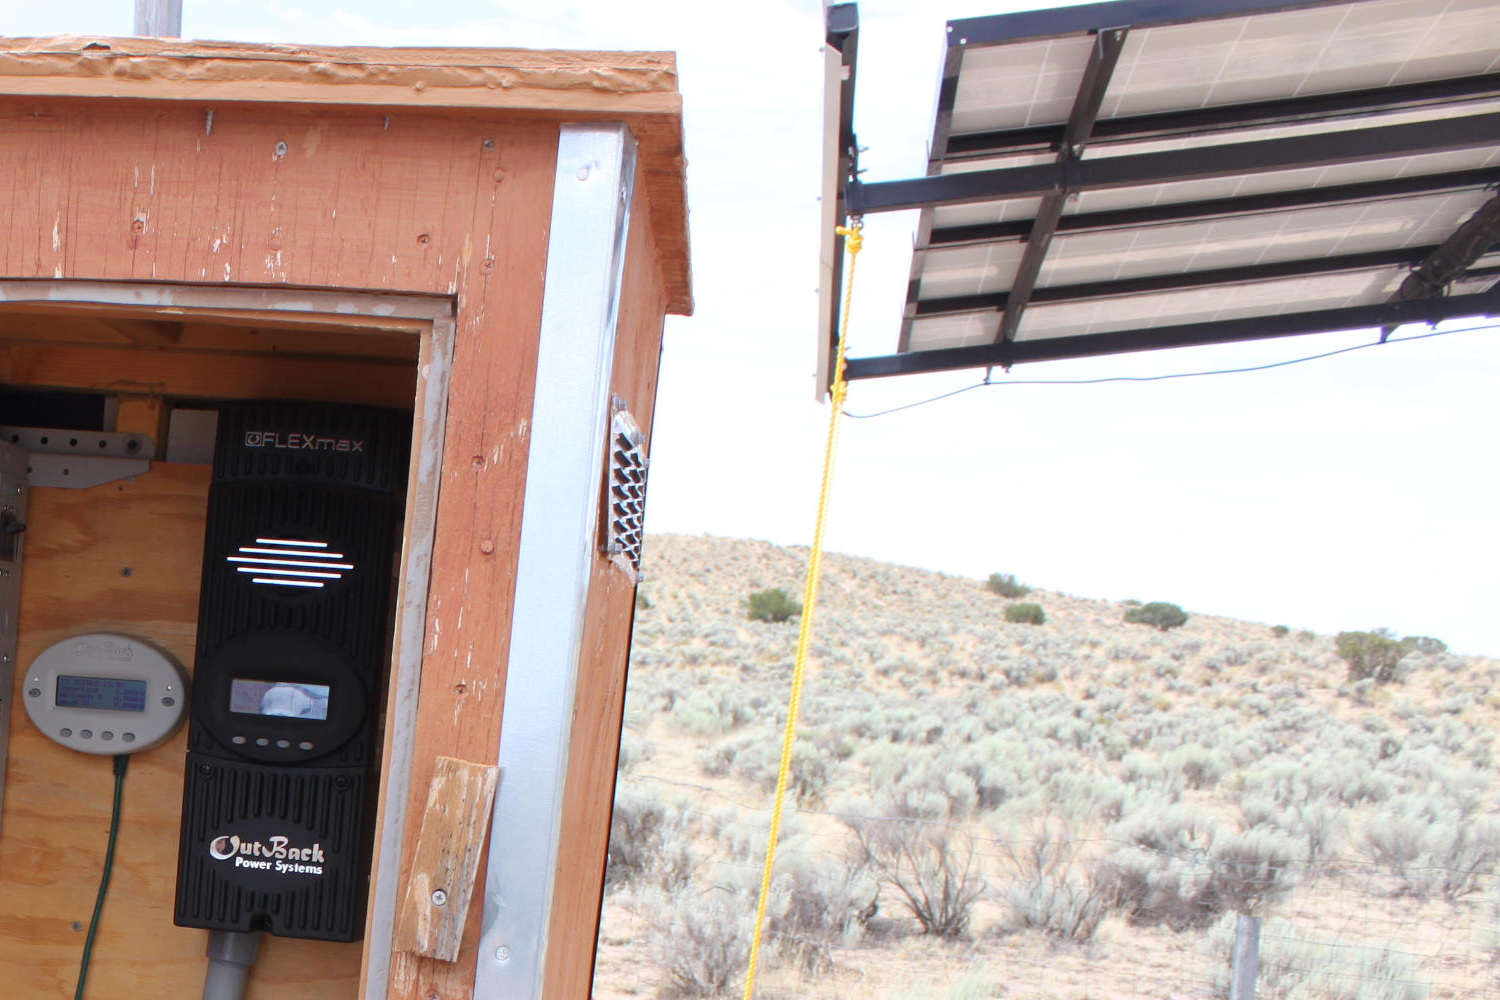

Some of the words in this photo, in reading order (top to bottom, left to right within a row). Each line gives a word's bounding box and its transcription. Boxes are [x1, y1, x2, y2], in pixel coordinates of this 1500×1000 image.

[262, 432, 364, 452] FLEXmax
[210, 835, 325, 863] OutBack
[235, 857, 272, 870] Power
[275, 860, 323, 875] Systems
